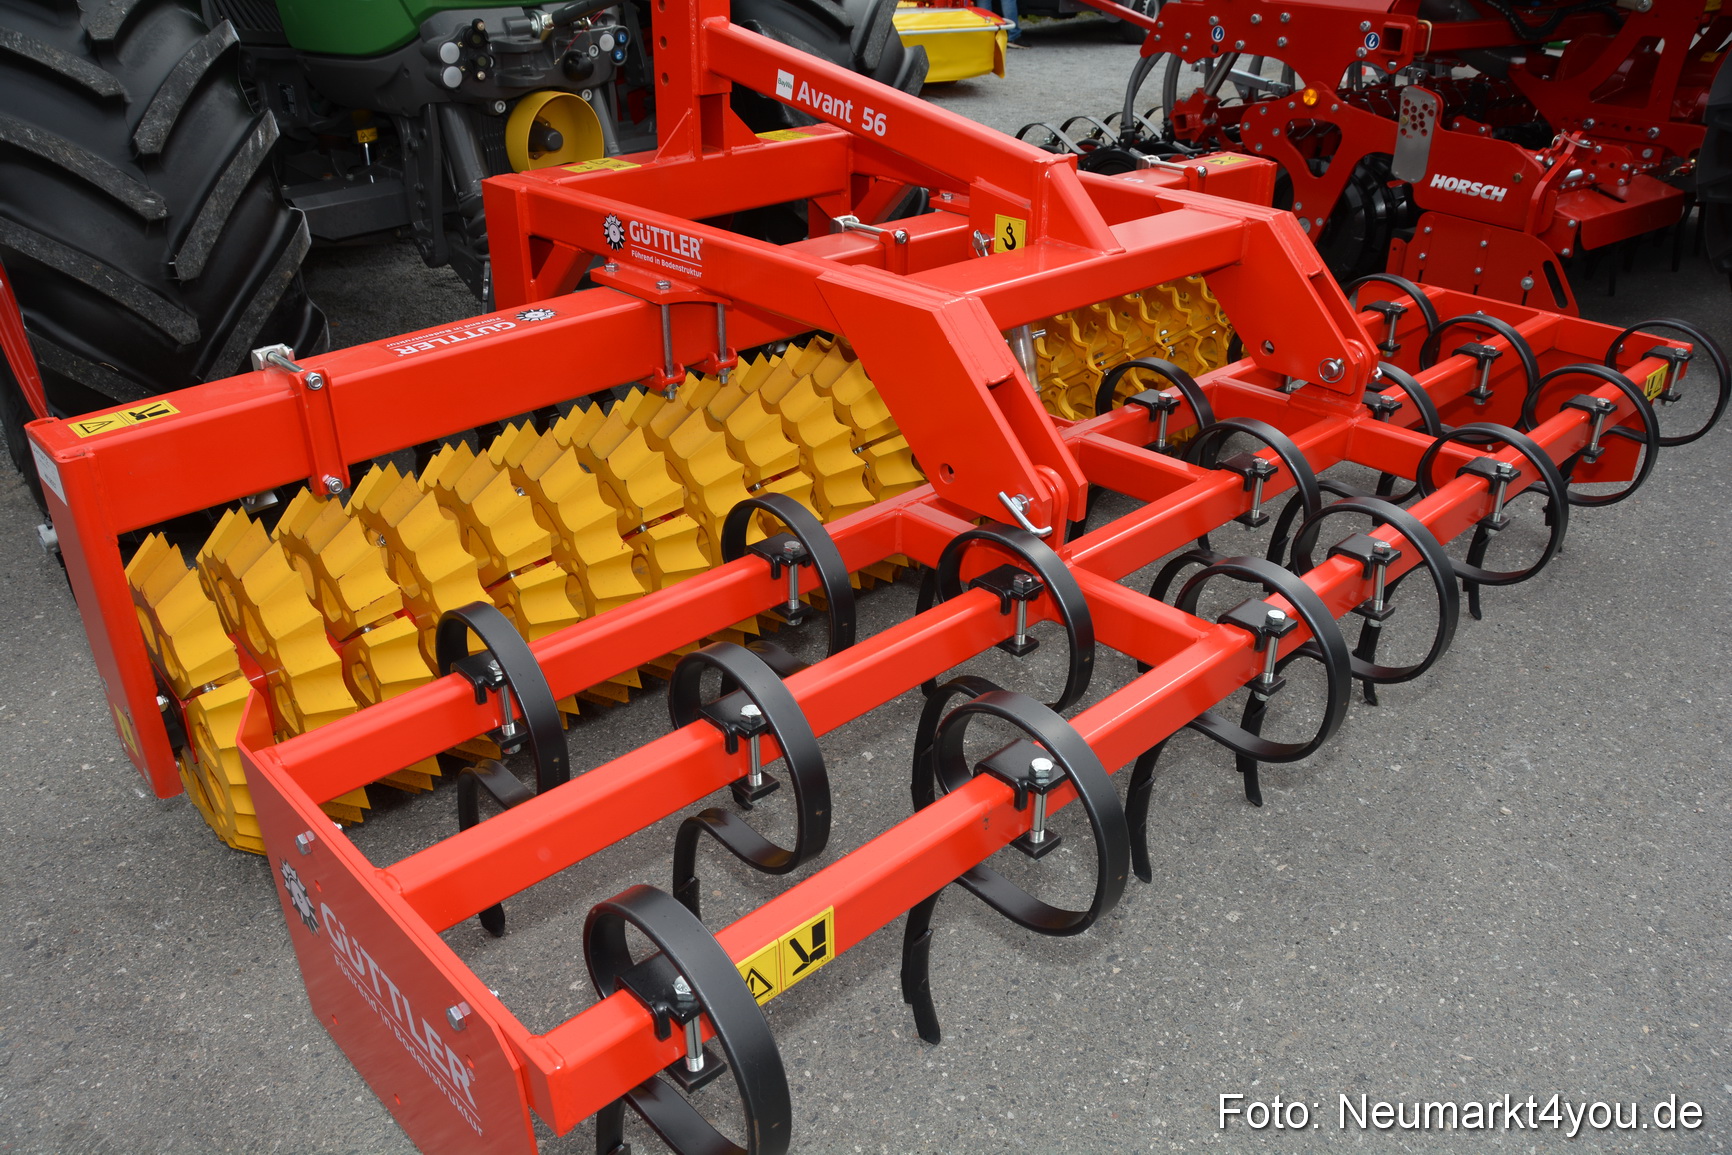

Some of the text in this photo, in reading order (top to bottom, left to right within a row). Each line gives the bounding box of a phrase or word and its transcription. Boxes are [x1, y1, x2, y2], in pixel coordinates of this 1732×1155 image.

[796, 80, 887, 137] Avant 56
[1429, 173, 1508, 202] HORSCH
[629, 220, 702, 261] GÜTTLER
[631, 250, 702, 277] Führend in Bodenstruktur
[320, 902, 478, 1109] GÜTTLER
[334, 955, 484, 1138] Führend in Bodenstruktur
